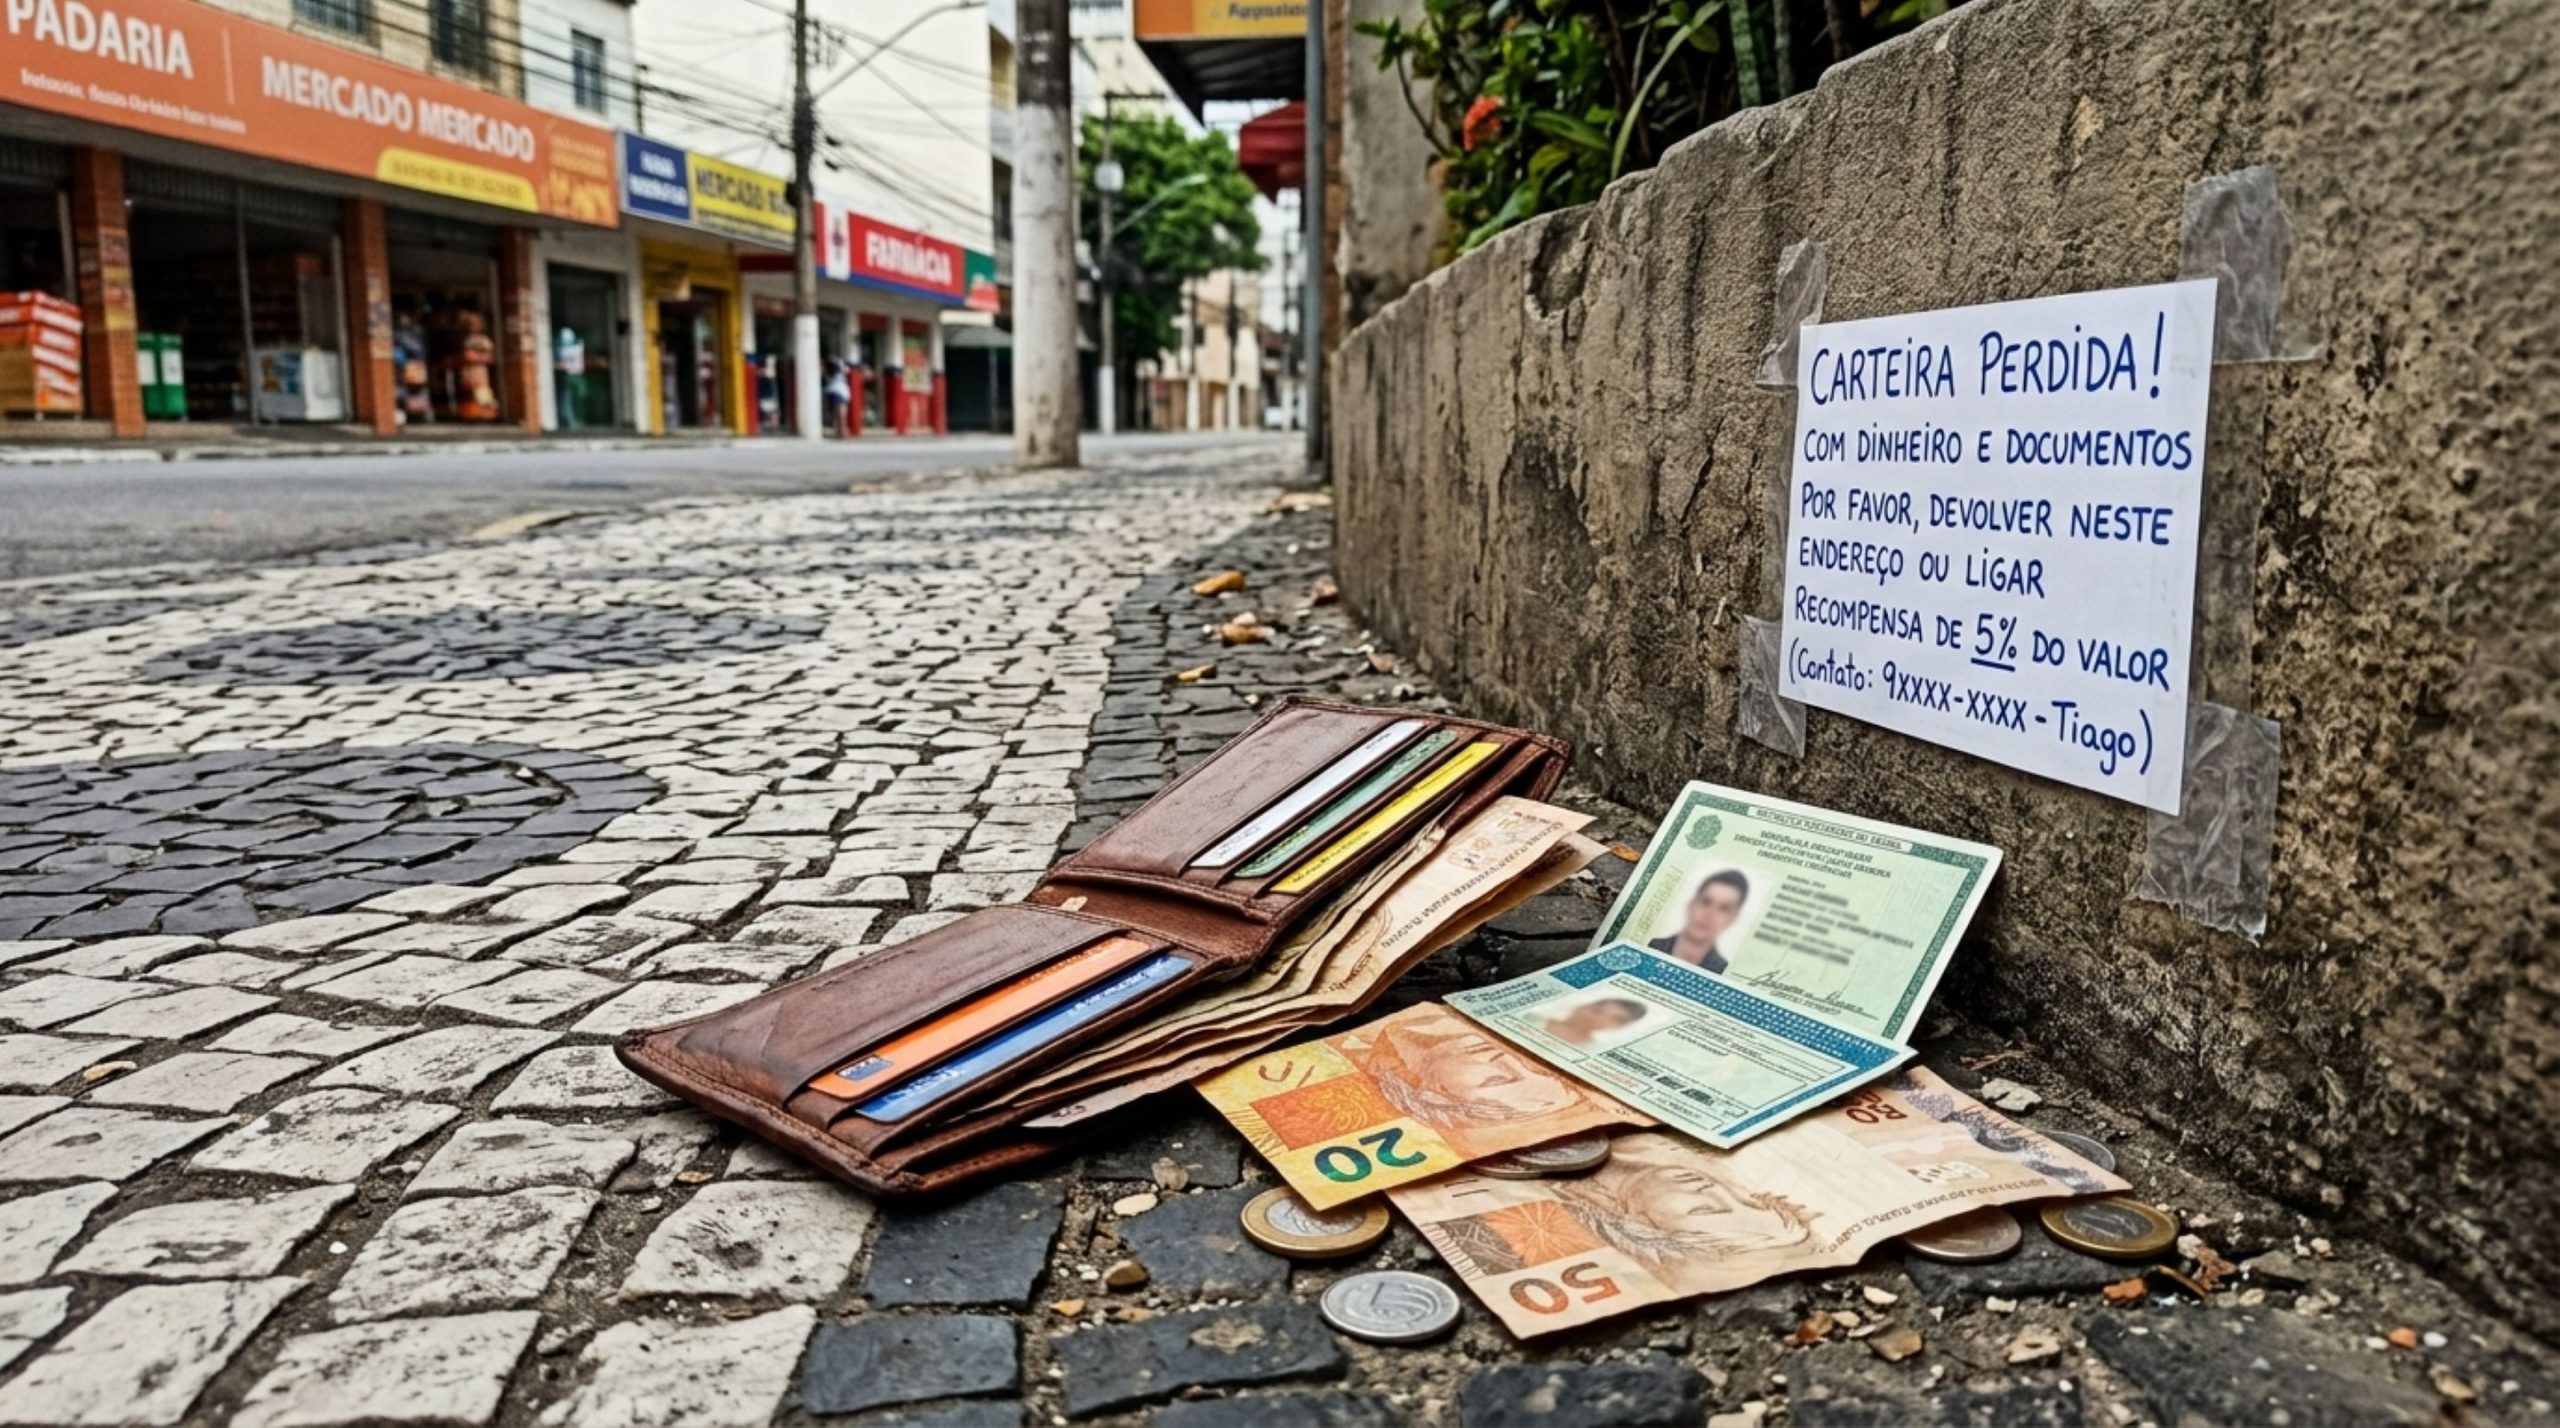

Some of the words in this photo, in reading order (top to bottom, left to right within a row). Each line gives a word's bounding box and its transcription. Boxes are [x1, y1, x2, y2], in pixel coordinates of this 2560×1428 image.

[7, 0, 194, 80] PADARIA
[262, 56, 413, 132] MERCADO
[418, 98, 535, 164] MERCADO
[865, 230, 953, 287] FARMÁCIA
[1811, 337, 1955, 405] CARTEIRA
[1979, 310, 2166, 400] PERDIDA!
[1803, 428, 1845, 463] COM
[1857, 421, 1963, 464] DINHEIRO
[1977, 430, 1992, 463] E
[2005, 428, 2193, 471] DOCUMENTOS
[1801, 481, 1836, 520] POR
[1847, 488, 1920, 535] FAVOR,
[1929, 493, 2053, 538] DEVOLVER
[2070, 503, 2174, 546] NESTE
[1800, 536, 1903, 586] ENDEREÇO
[1919, 552, 1950, 584] OU
[1965, 547, 2045, 599] LIGAR
[1789, 637, 1874, 691] (Contato:
[1795, 585, 1923, 643] RECOMPENSA
[1936, 616, 1963, 649] DE
[1974, 612, 2018, 665] 5%
[2032, 629, 2066, 666] DO
[2078, 640, 2170, 691] VALOR
[1313, 1126, 1428, 1184] 20
[1508, 1260, 1623, 1316] 50
